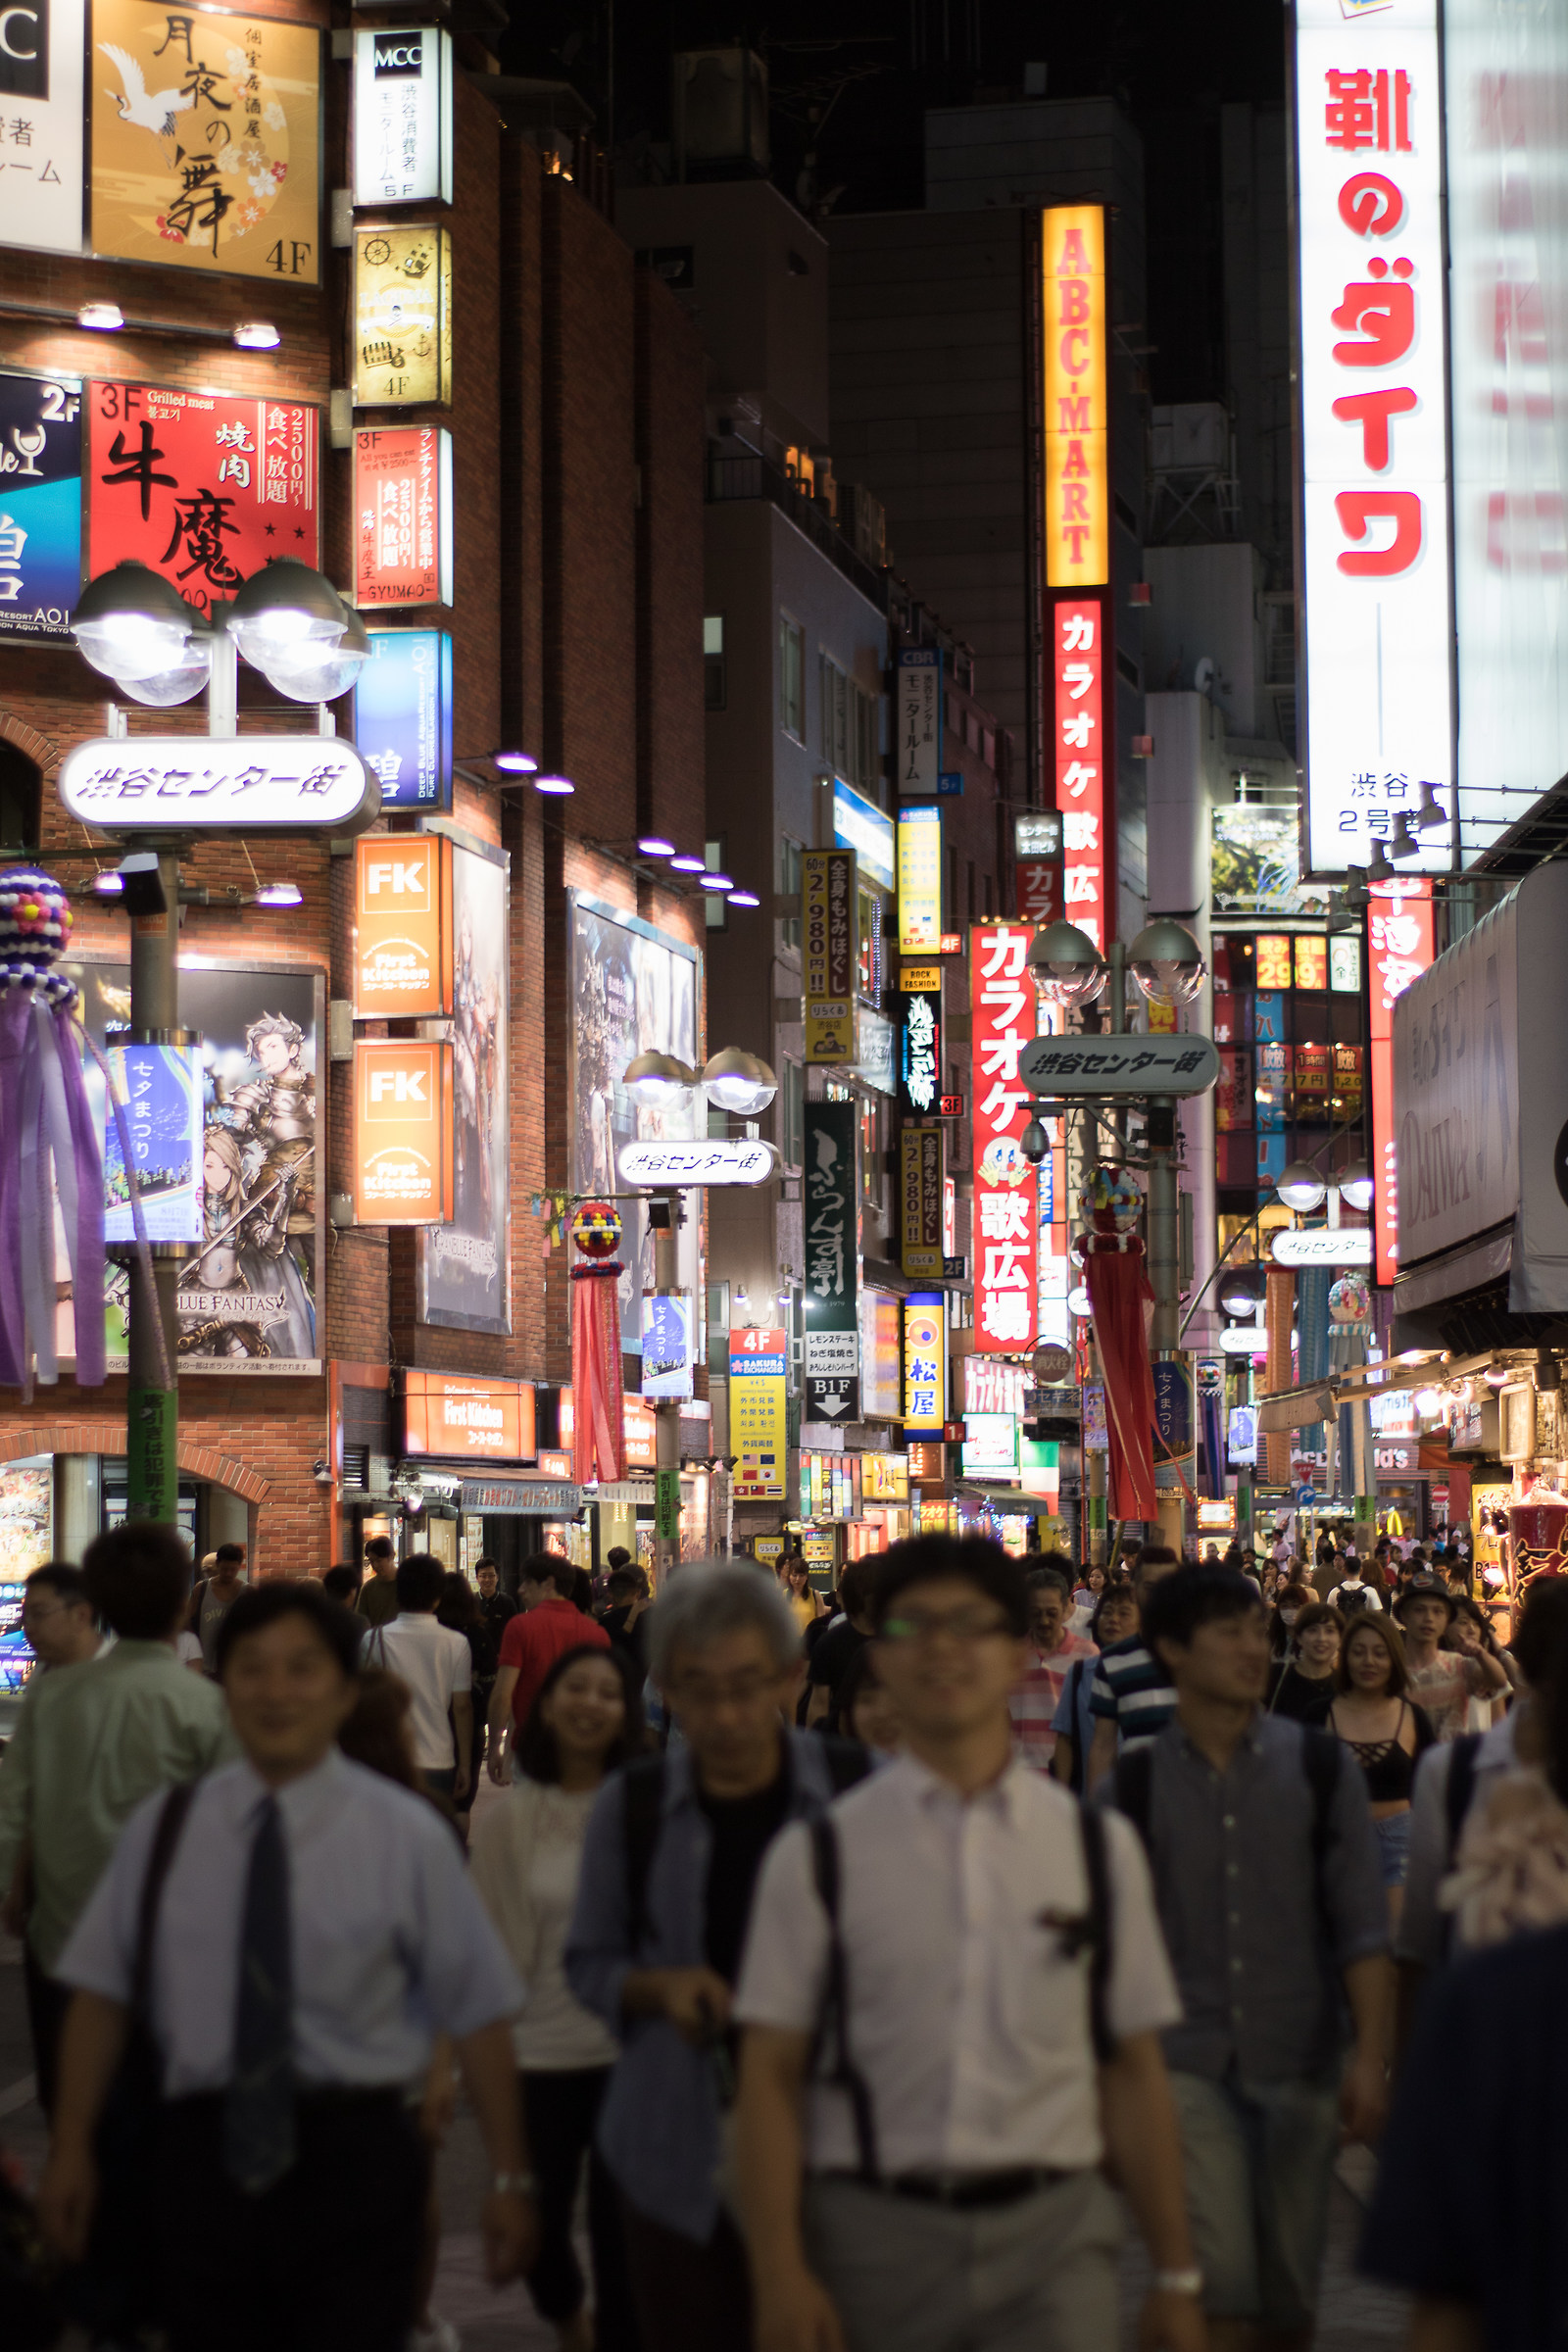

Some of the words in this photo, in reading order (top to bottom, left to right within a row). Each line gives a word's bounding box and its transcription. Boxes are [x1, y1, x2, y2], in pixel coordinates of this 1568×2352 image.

[374, 46, 422, 68] MCC
[244, 28, 263, 139] 個室居酒屋
[153, 15, 234, 258] 月夜の舞
[379, 92, 394, 180] モニタールーム
[0, 159, 61, 184] ーム
[266, 239, 312, 275] 4F
[1325, 69, 1422, 576] 靴のダイワ
[383, 376, 410, 396] 4F
[1056, 228, 1092, 564] ABC-MART
[42, 384, 79, 422] 2F
[101, 385, 141, 421] 3F
[147, 391, 186, 408] Grilled
[187, 397, 216, 411] meat
[359, 432, 382, 450] 3F
[266, 407, 288, 505] 食べ放題
[361, 454, 372, 463] All
[373, 453, 388, 463] you
[418, 428, 433, 570] ランチタイムから営業中
[383, 480, 399, 566] 食べ放題
[361, 532, 375, 580] 牛魔王
[34, 608, 69, 625] AOI
[412, 638, 427, 674] AOI
[906, 674, 920, 780] モニタールーム
[76, 764, 348, 799] 渋谷センター街
[1350, 772, 1408, 798] 渋谷
[1017, 825, 1058, 837] センター街
[368, 862, 424, 894] FK
[806, 858, 825, 871] 60分
[831, 859, 848, 994] 全身もみほぐし
[941, 939, 958, 951] 4F
[374, 954, 416, 967] First
[363, 967, 430, 982] Kitchen
[906, 980, 937, 989] FASHION
[910, 970, 931, 979] ROCK
[813, 1006, 845, 1016] りらくる
[981, 927, 1029, 1132] カラオケ
[1029, 1051, 1206, 1075] 渋谷センター街
[370, 1071, 427, 1102] FK
[132, 1061, 154, 1159] 七夕まつり
[944, 1099, 959, 1112] 3F
[376, 1162, 418, 1176] First
[627, 1153, 762, 1170] 渋谷センター街
[1399, 1105, 1470, 1228] DAIWA
[364, 1176, 431, 1190] Kitchen
[923, 1137, 938, 1244] 全身もみほぐし
[1280, 1241, 1370, 1254] 渋谷センター
[945, 1261, 962, 1275] 2F
[980, 1191, 1031, 1341] 歌広場
[655, 1304, 666, 1356] 七夕まつり
[743, 1331, 770, 1351] 4F
[809, 1335, 855, 1344] レモンステーキ
[809, 1348, 855, 1357] ねぎ塩焼き
[1035, 1354, 1068, 1370] 消火栓
[814, 1380, 851, 1394] B1F
[909, 1358, 937, 1416] 松屋
[444, 1399, 467, 1426] First
[467, 1401, 504, 1428] Kitchen
[1158, 1372, 1172, 1436] 七夕まつり
[144, 1394, 166, 1518] 客引きは犯罪です
